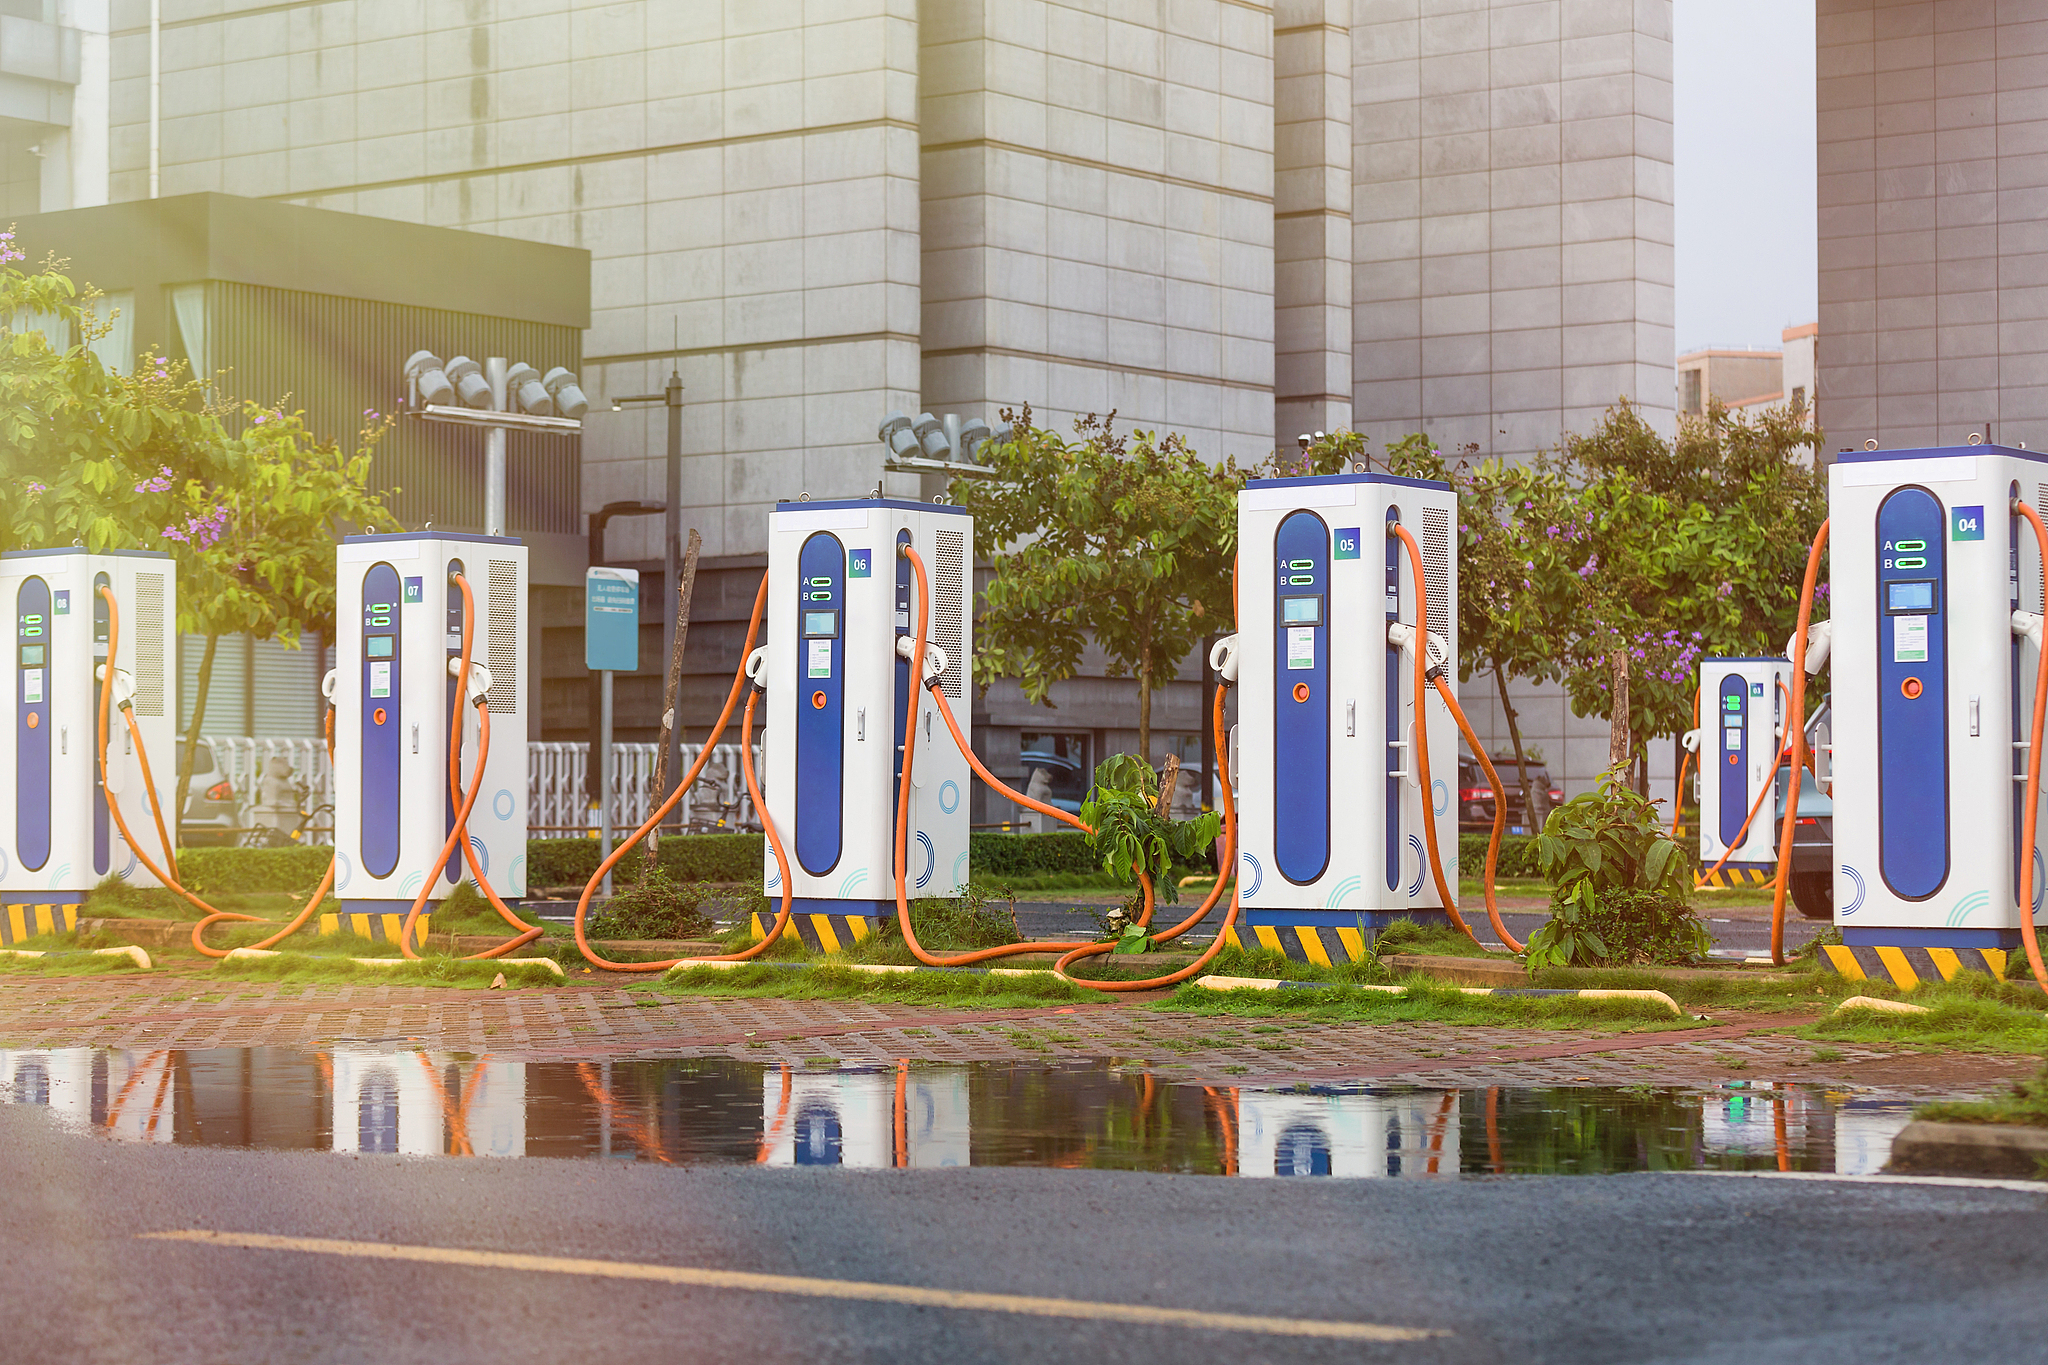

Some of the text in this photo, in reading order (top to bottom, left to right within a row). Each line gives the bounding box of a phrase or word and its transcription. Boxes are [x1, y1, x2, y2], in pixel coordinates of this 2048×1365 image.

[1958, 518, 1977, 531] 04
[1340, 539, 1354, 551] 05
[1884, 541, 1893, 550] A
[853, 559, 866, 570] 06
[1280, 560, 1287, 569] A
[1884, 559, 1893, 569] B
[803, 577, 810, 586] A
[1280, 576, 1287, 586] B
[407, 586, 419, 597] 07
[803, 592, 809, 601] B
[365, 604, 371, 612] A
[19, 615, 25, 623] A
[365, 618, 371, 626] B
